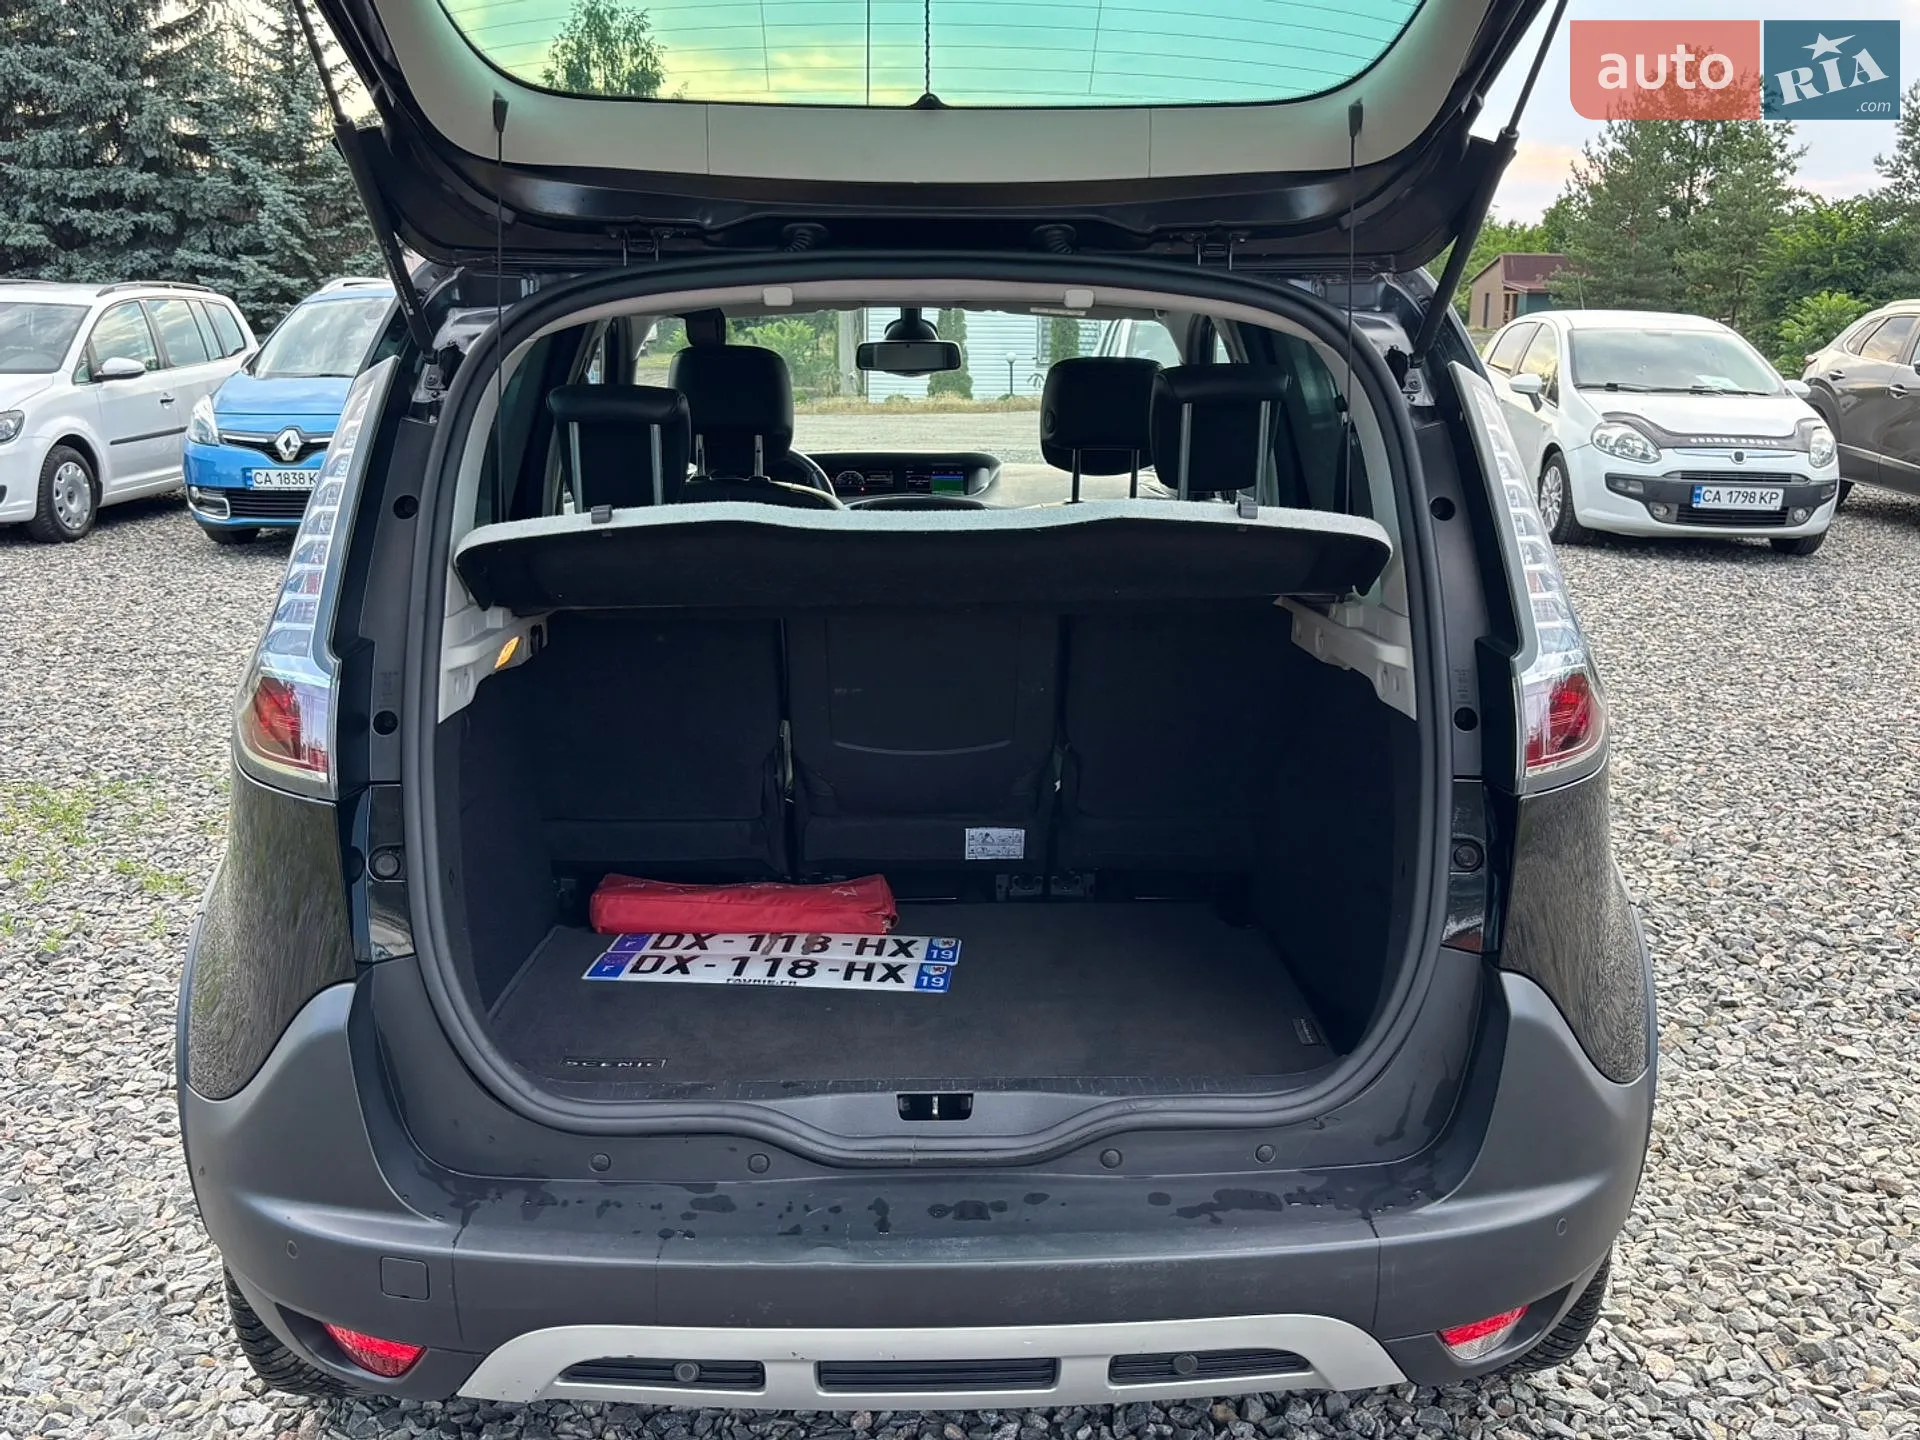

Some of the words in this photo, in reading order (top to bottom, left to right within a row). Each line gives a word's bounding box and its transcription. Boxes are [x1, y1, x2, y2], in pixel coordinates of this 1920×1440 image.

[253, 472, 273, 485] CA
[276, 472, 306, 485] 1838
[308, 472, 319, 485] K
[1702, 489, 1721, 503] CA
[1727, 490, 1757, 504] 1798
[1758, 491, 1780, 504] KP
[930, 949, 953, 960] 19
[920, 975, 945, 987] 19
